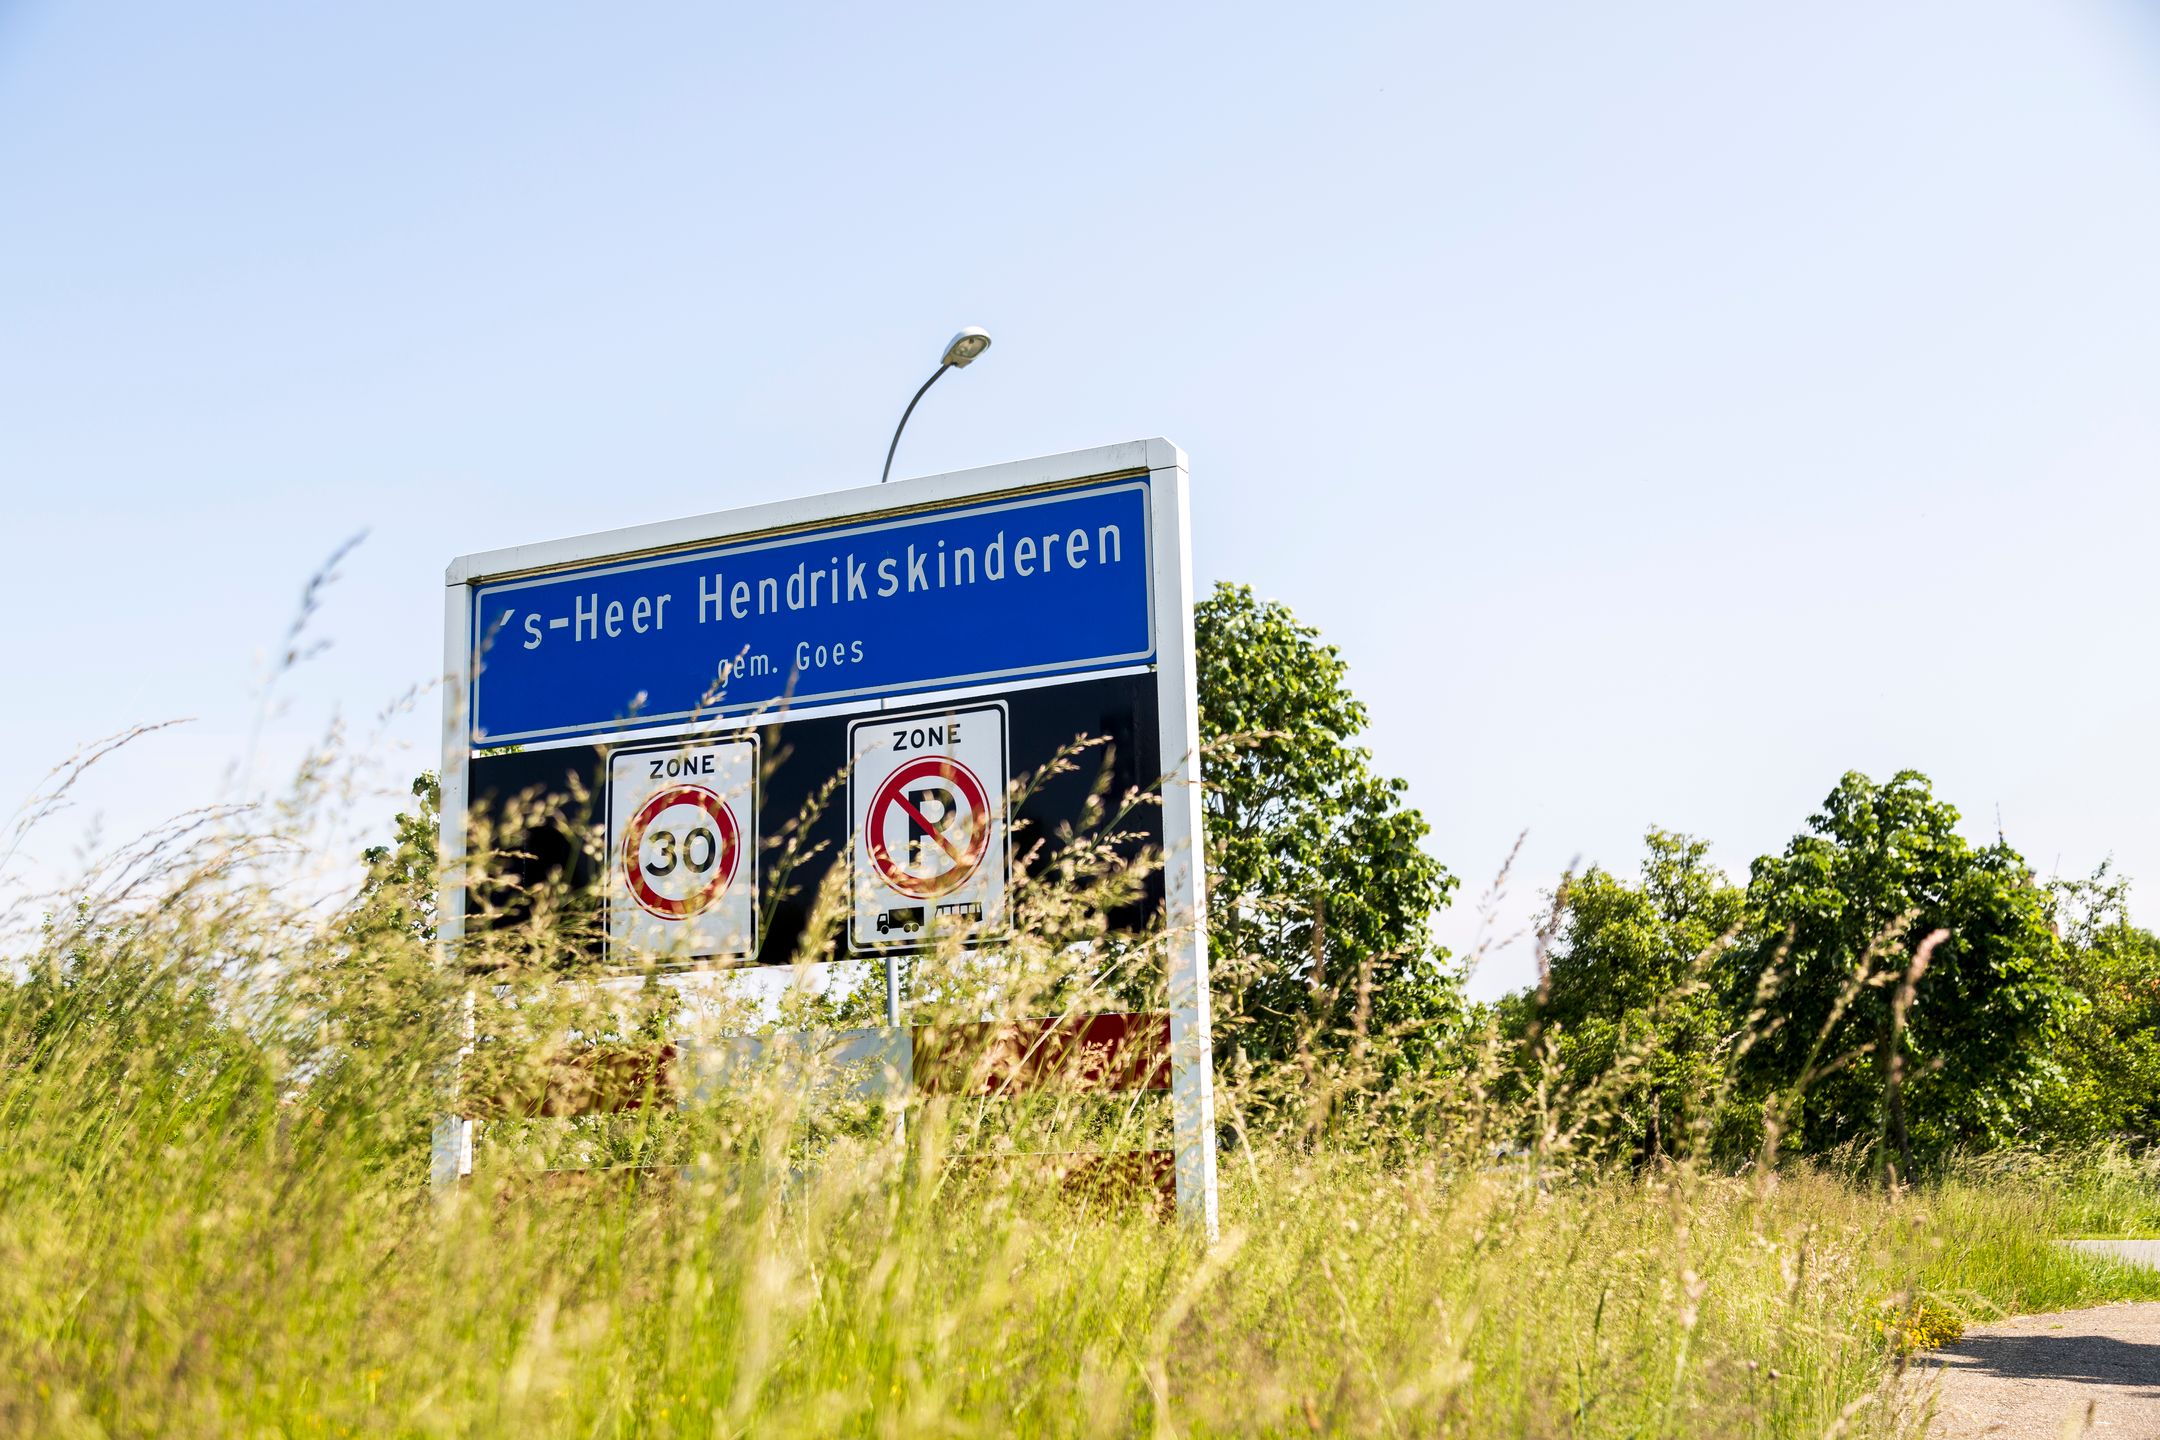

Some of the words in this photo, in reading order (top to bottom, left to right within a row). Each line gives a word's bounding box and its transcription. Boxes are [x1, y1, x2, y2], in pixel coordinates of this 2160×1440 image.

[699, 524, 1121, 624] Hendrikskinderen
[796, 640, 864, 671] Goes
[893, 724, 961, 751] ZONE
[650, 754, 715, 779] ZONE
[908, 788, 957, 868] P
[645, 827, 716, 877] 30
